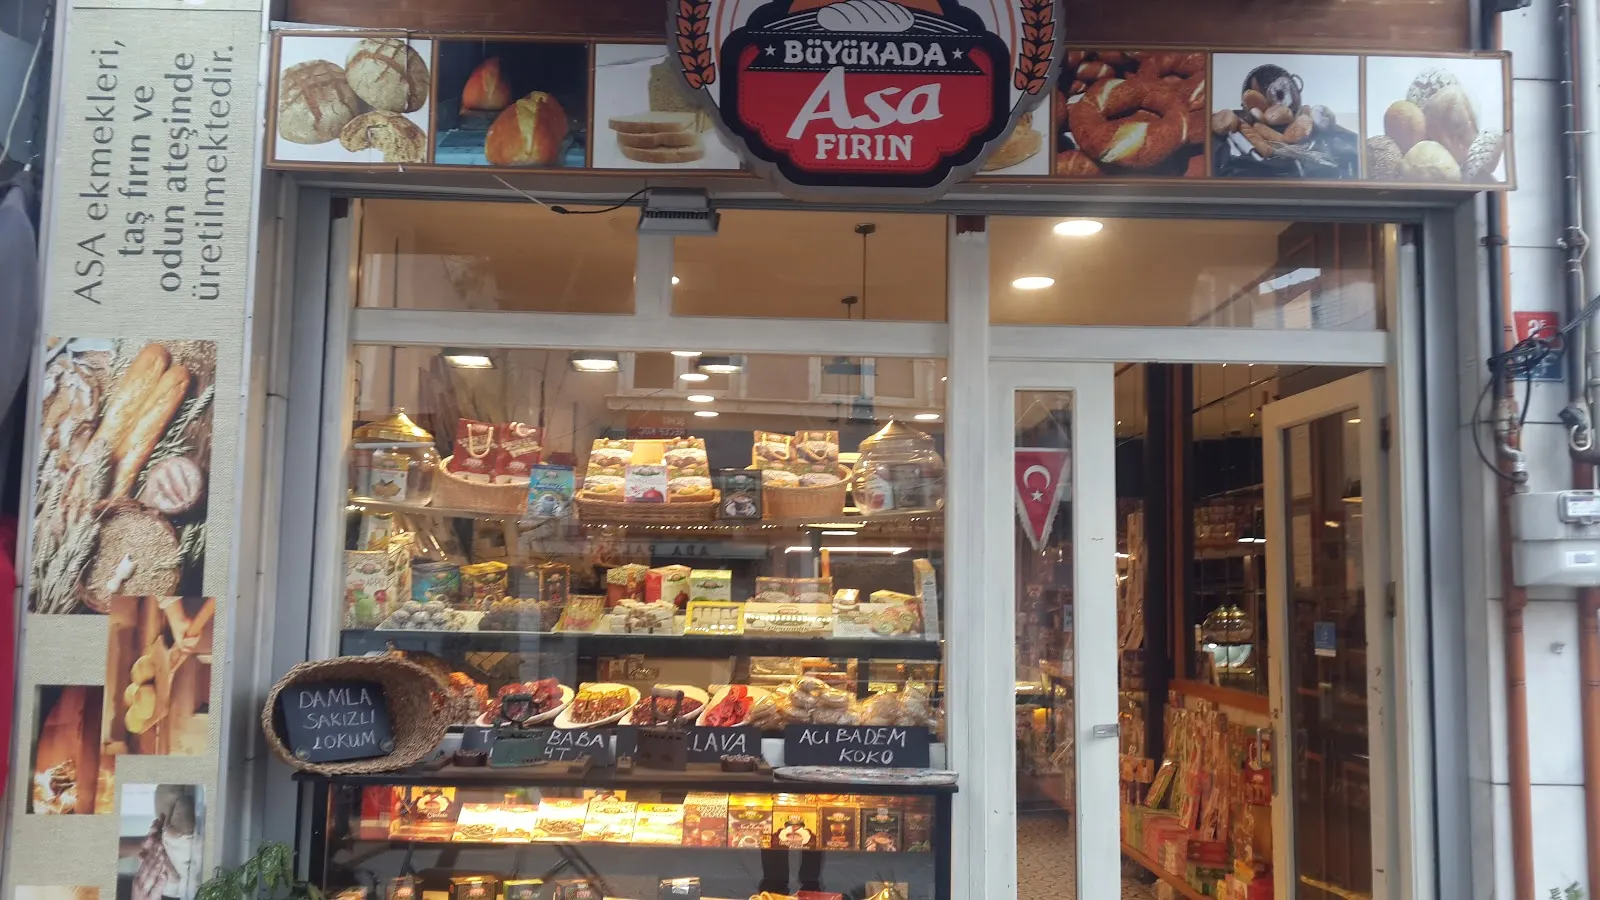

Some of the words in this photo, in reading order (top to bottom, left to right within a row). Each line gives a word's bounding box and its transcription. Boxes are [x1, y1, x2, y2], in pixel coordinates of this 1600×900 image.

[132, 85, 154, 122] ve
[786, 66, 944, 140] Asa
[79, 40, 126, 221] ekmekleri,
[162, 52, 198, 193] ateşinde
[117, 133, 151, 197] fırın
[815, 134, 913, 161] FIRIN
[192, 45, 234, 300] üretilmektedir.
[117, 210, 154, 257] taş
[152, 205, 185, 292] odun
[73, 233, 106, 305] ASA
[299, 687, 372, 710] DAMLA
[303, 711, 376, 730] SAKIZLI
[547, 729, 605, 748] BABA
[799, 729, 830, 745] ACI
[835, 728, 906, 748] BADEM
[312, 729, 376, 751] LOKUM
[686, 731, 746, 753] LAVA
[838, 748, 895, 765] KOKO
